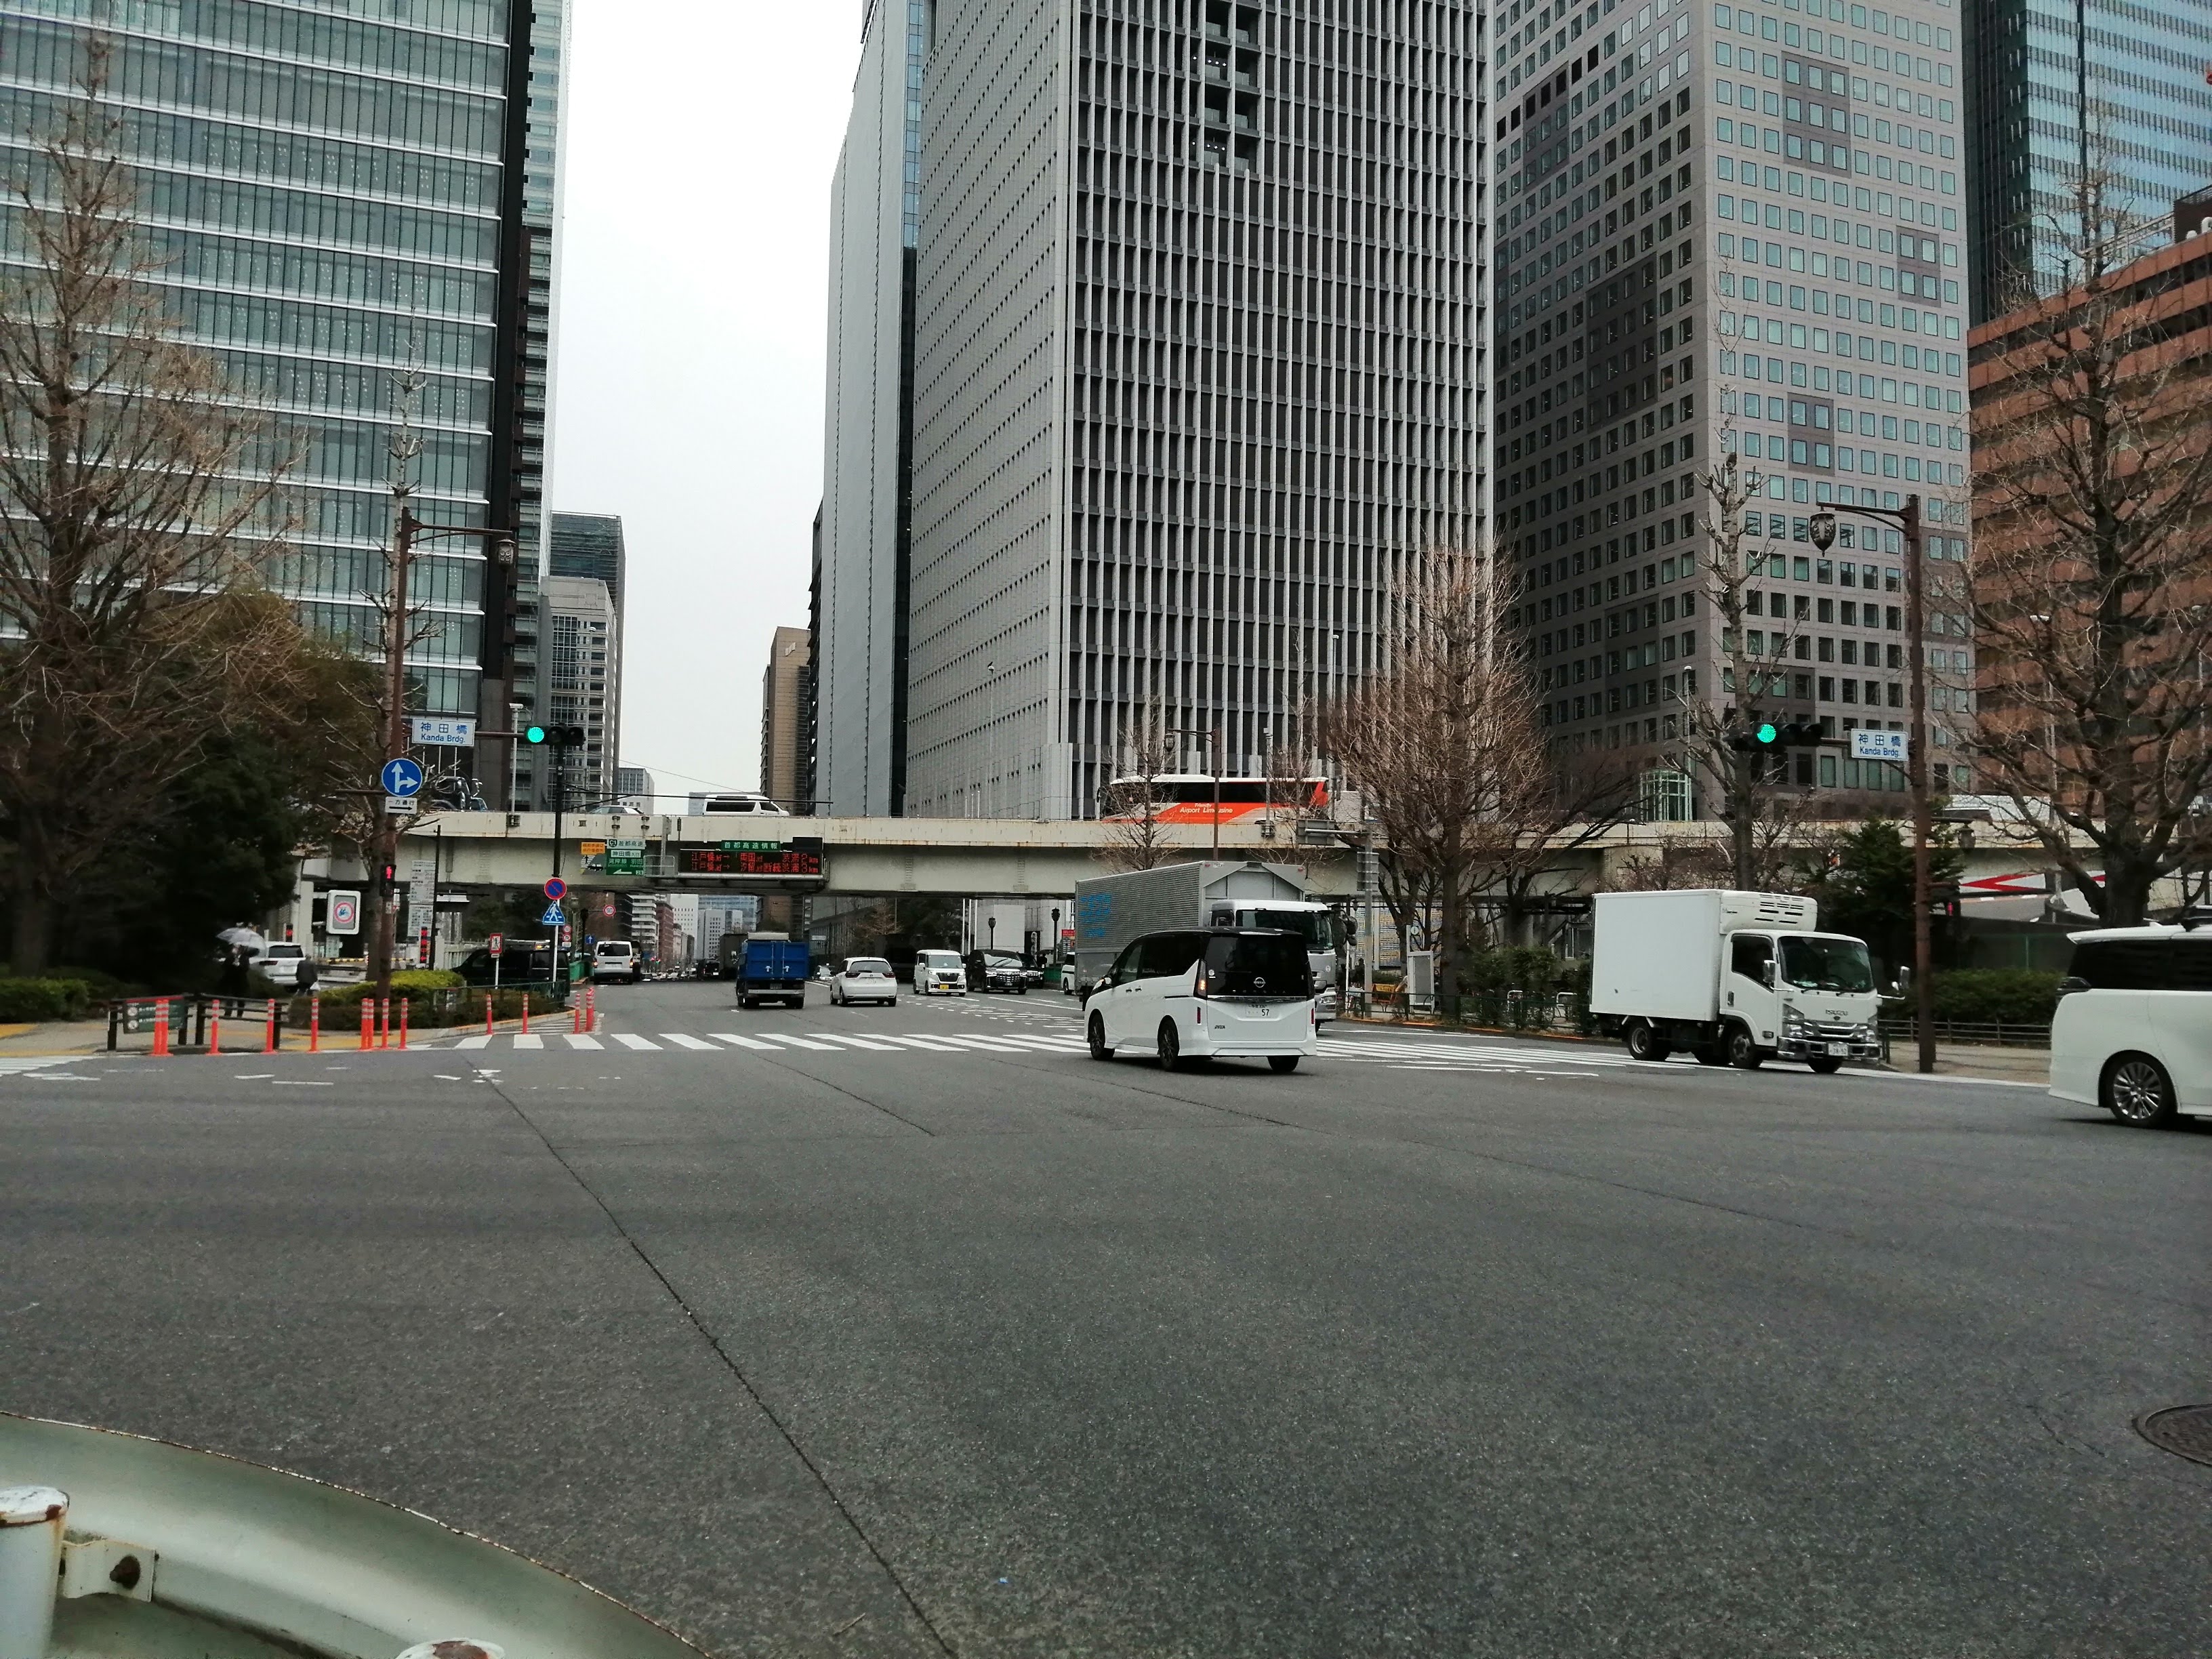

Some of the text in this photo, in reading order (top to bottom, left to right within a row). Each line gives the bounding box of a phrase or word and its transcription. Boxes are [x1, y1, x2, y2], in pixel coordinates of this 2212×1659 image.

[420, 722, 468, 735] 神田橋
[421, 733, 466, 743] Kanda Brdg.
[1858, 733, 1901, 747] 神田橋
[1860, 746, 1900, 758] Kanda Brdg.
[724, 842, 778, 850] 首都高速情報
